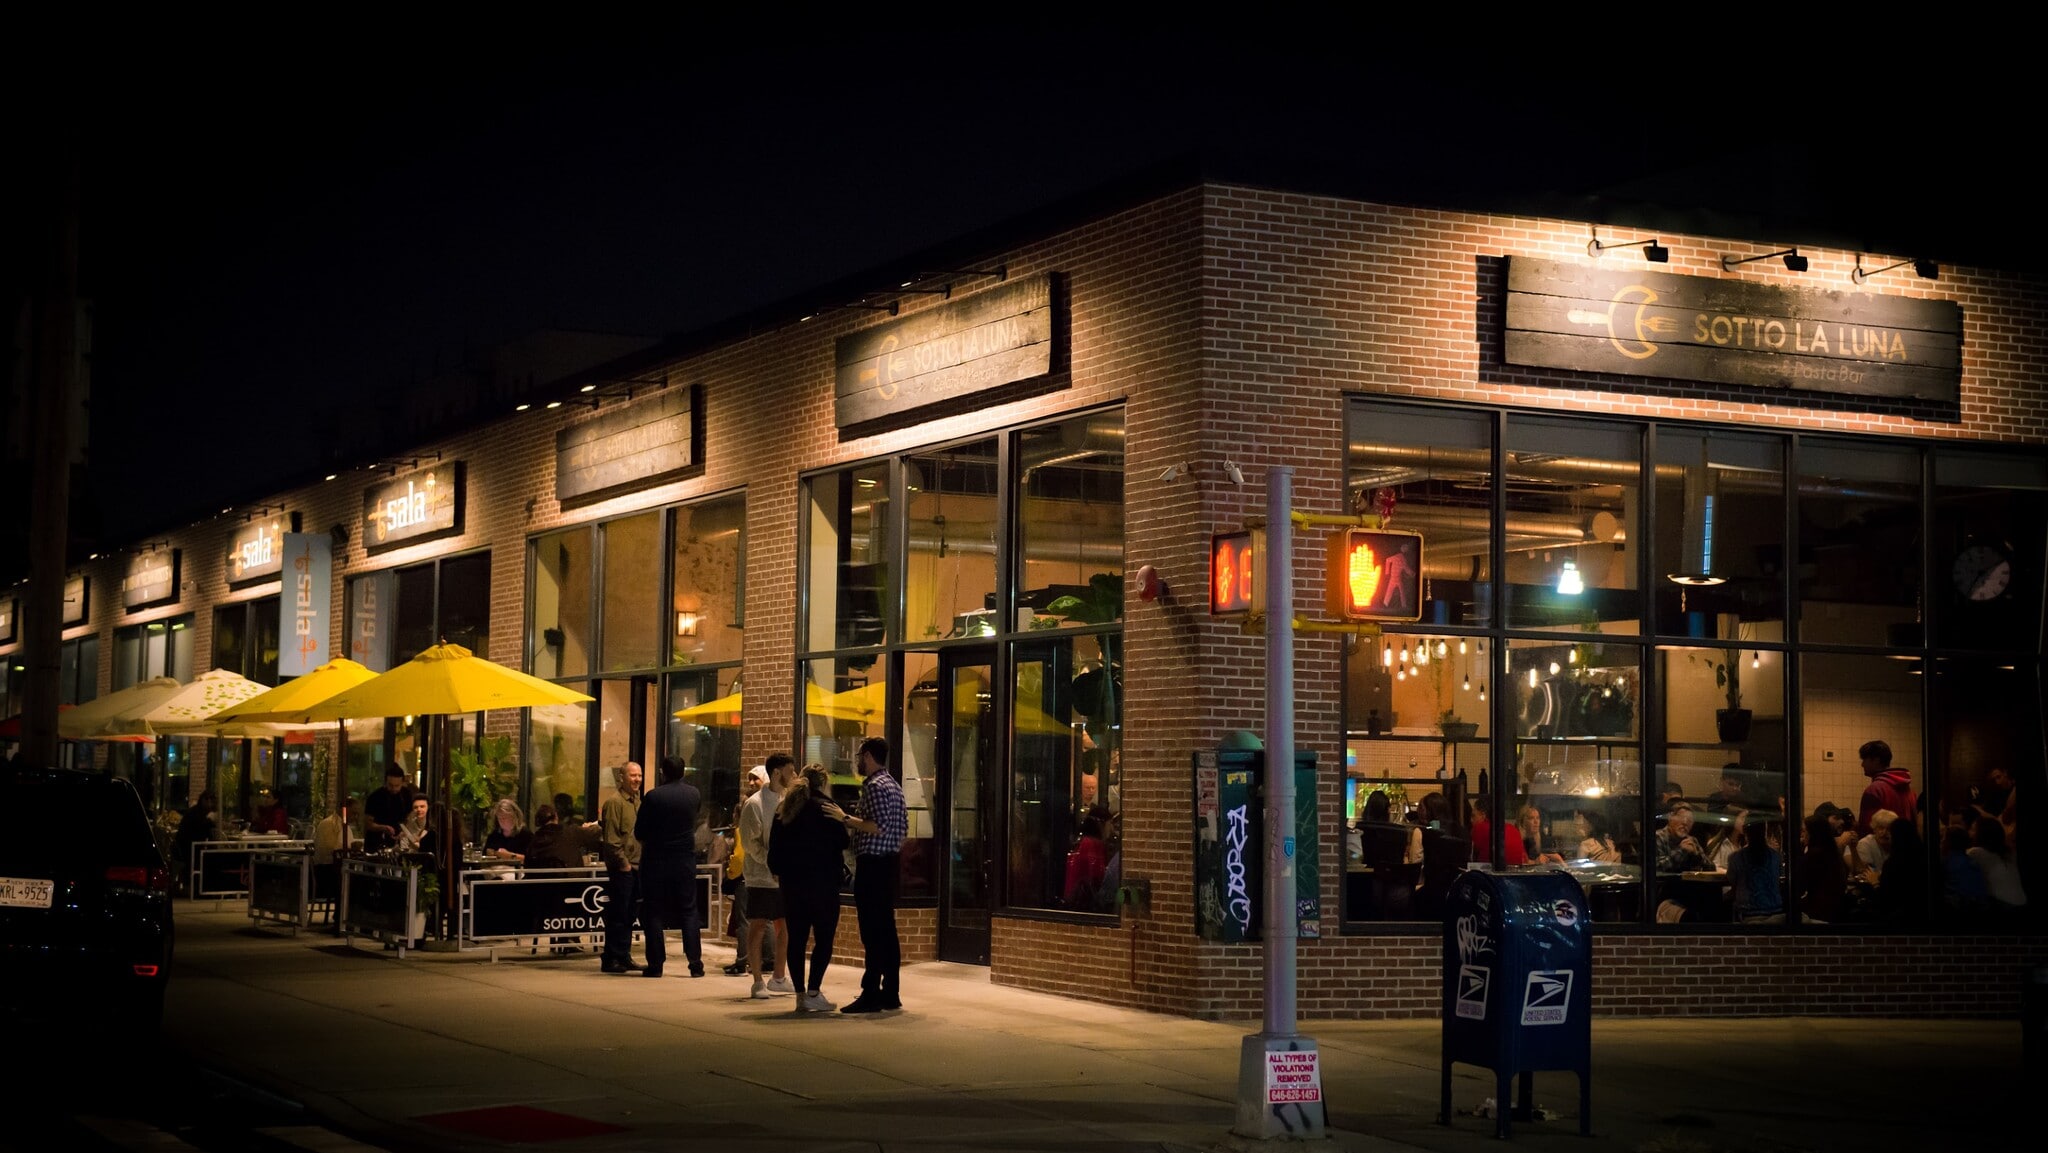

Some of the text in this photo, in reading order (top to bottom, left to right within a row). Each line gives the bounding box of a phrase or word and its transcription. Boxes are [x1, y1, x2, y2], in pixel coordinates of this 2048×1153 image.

[913, 319, 1020, 371] SOTTO LA LUNA
[1694, 314, 1907, 360] SOTTO LA LUNA
[1793, 362, 1836, 382] Pasta
[1839, 364, 1865, 385] Bar
[387, 481, 425, 531] sala
[243, 527, 271, 569] sala
[296, 574, 317, 635] sala
[25, 887, 48, 900] 9525
[543, 916, 606, 930] SOTTO LA
[1273, 1064, 1314, 1072] VIOLATIONS
